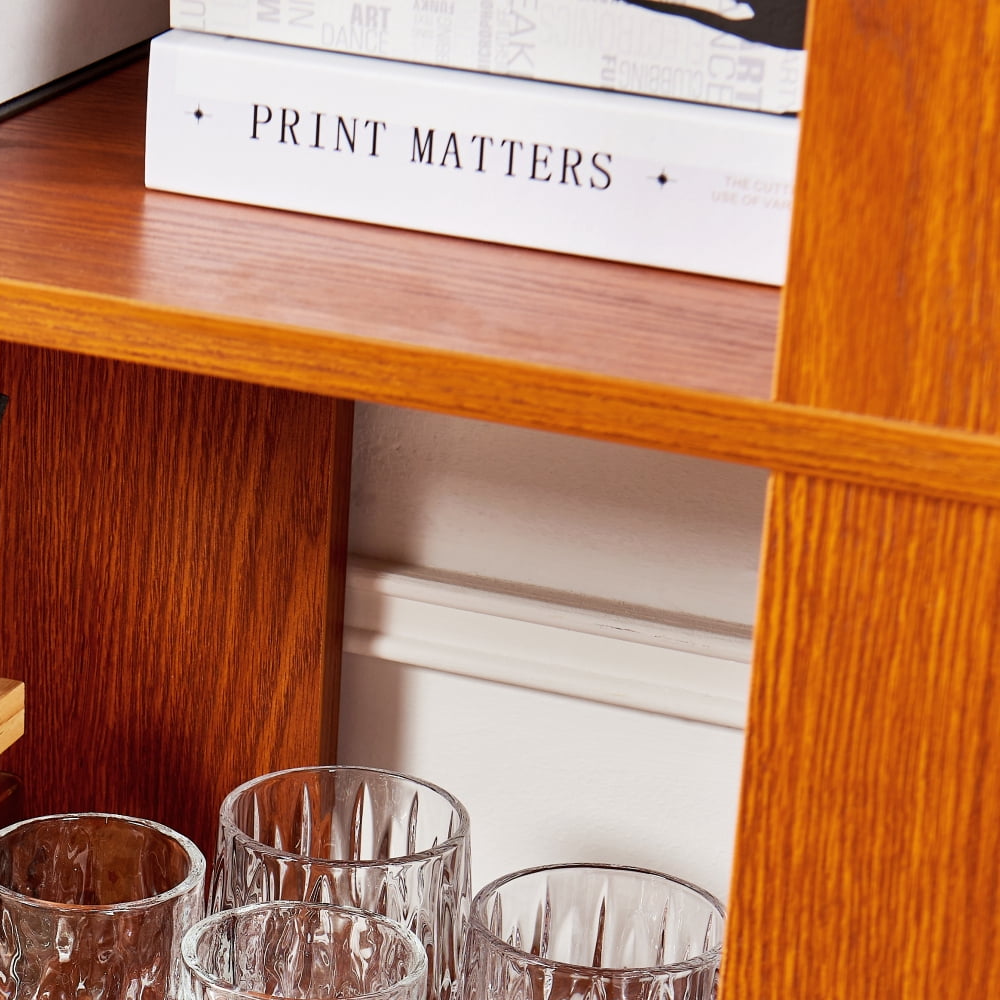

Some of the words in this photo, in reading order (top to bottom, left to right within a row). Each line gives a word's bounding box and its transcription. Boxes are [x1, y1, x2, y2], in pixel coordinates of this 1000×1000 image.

[350, 3, 391, 29] ART
[321, 22, 386, 54] DANCE
[250, 103, 387, 157] PRINT
[410, 126, 613, 191] MATTERS
